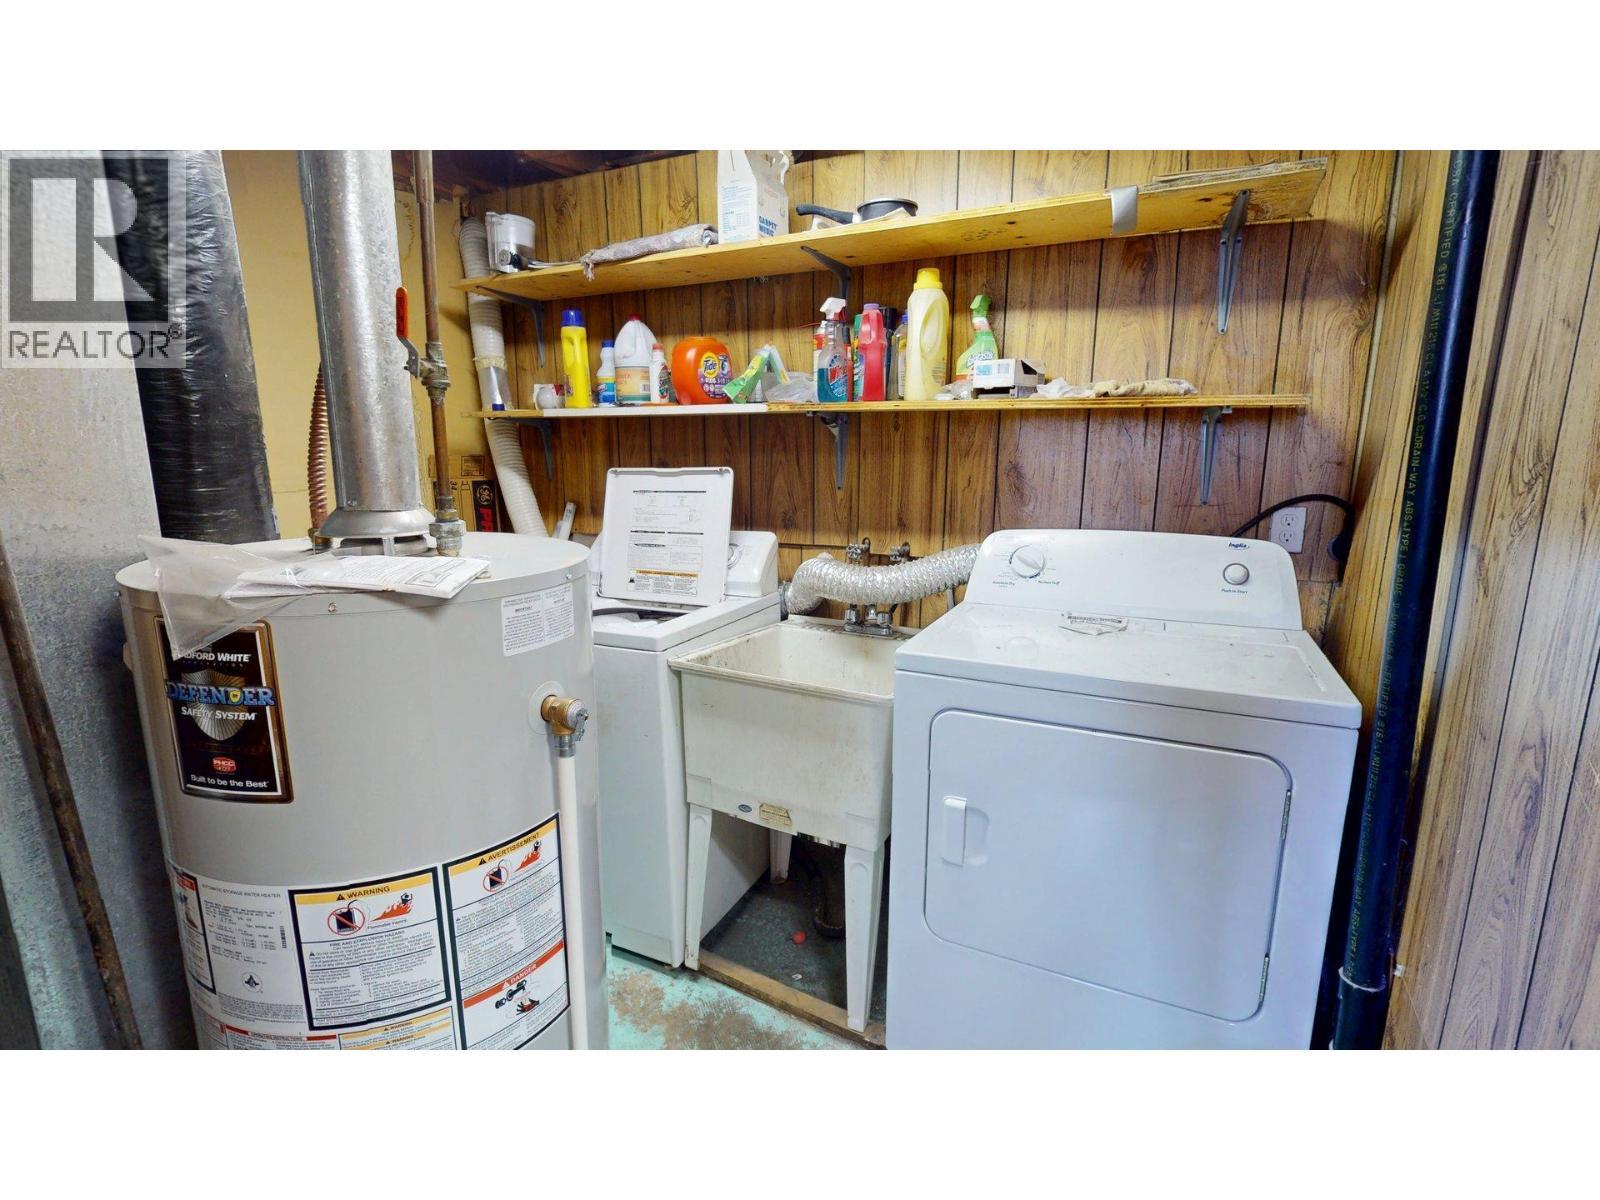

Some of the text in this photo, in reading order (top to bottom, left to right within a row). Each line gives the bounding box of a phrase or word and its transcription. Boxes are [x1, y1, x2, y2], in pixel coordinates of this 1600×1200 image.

[1441, 193, 1458, 258] CERTIFIED
[703, 359, 718, 372] Tide
[1403, 501, 1415, 521] ABS
[217, 652, 251, 662] WHITE
[166, 682, 275, 706] DEFENDER
[181, 706, 213, 718] SAFETY
[190, 774, 206, 783] Built
[207, 777, 216, 785] to
[217, 778, 228, 786] be
[246, 780, 268, 788] Best
[488, 832, 540, 861] AVERTISSEMENT
[347, 886, 391, 898] WARNING
[511, 963, 538, 983] DANGER
